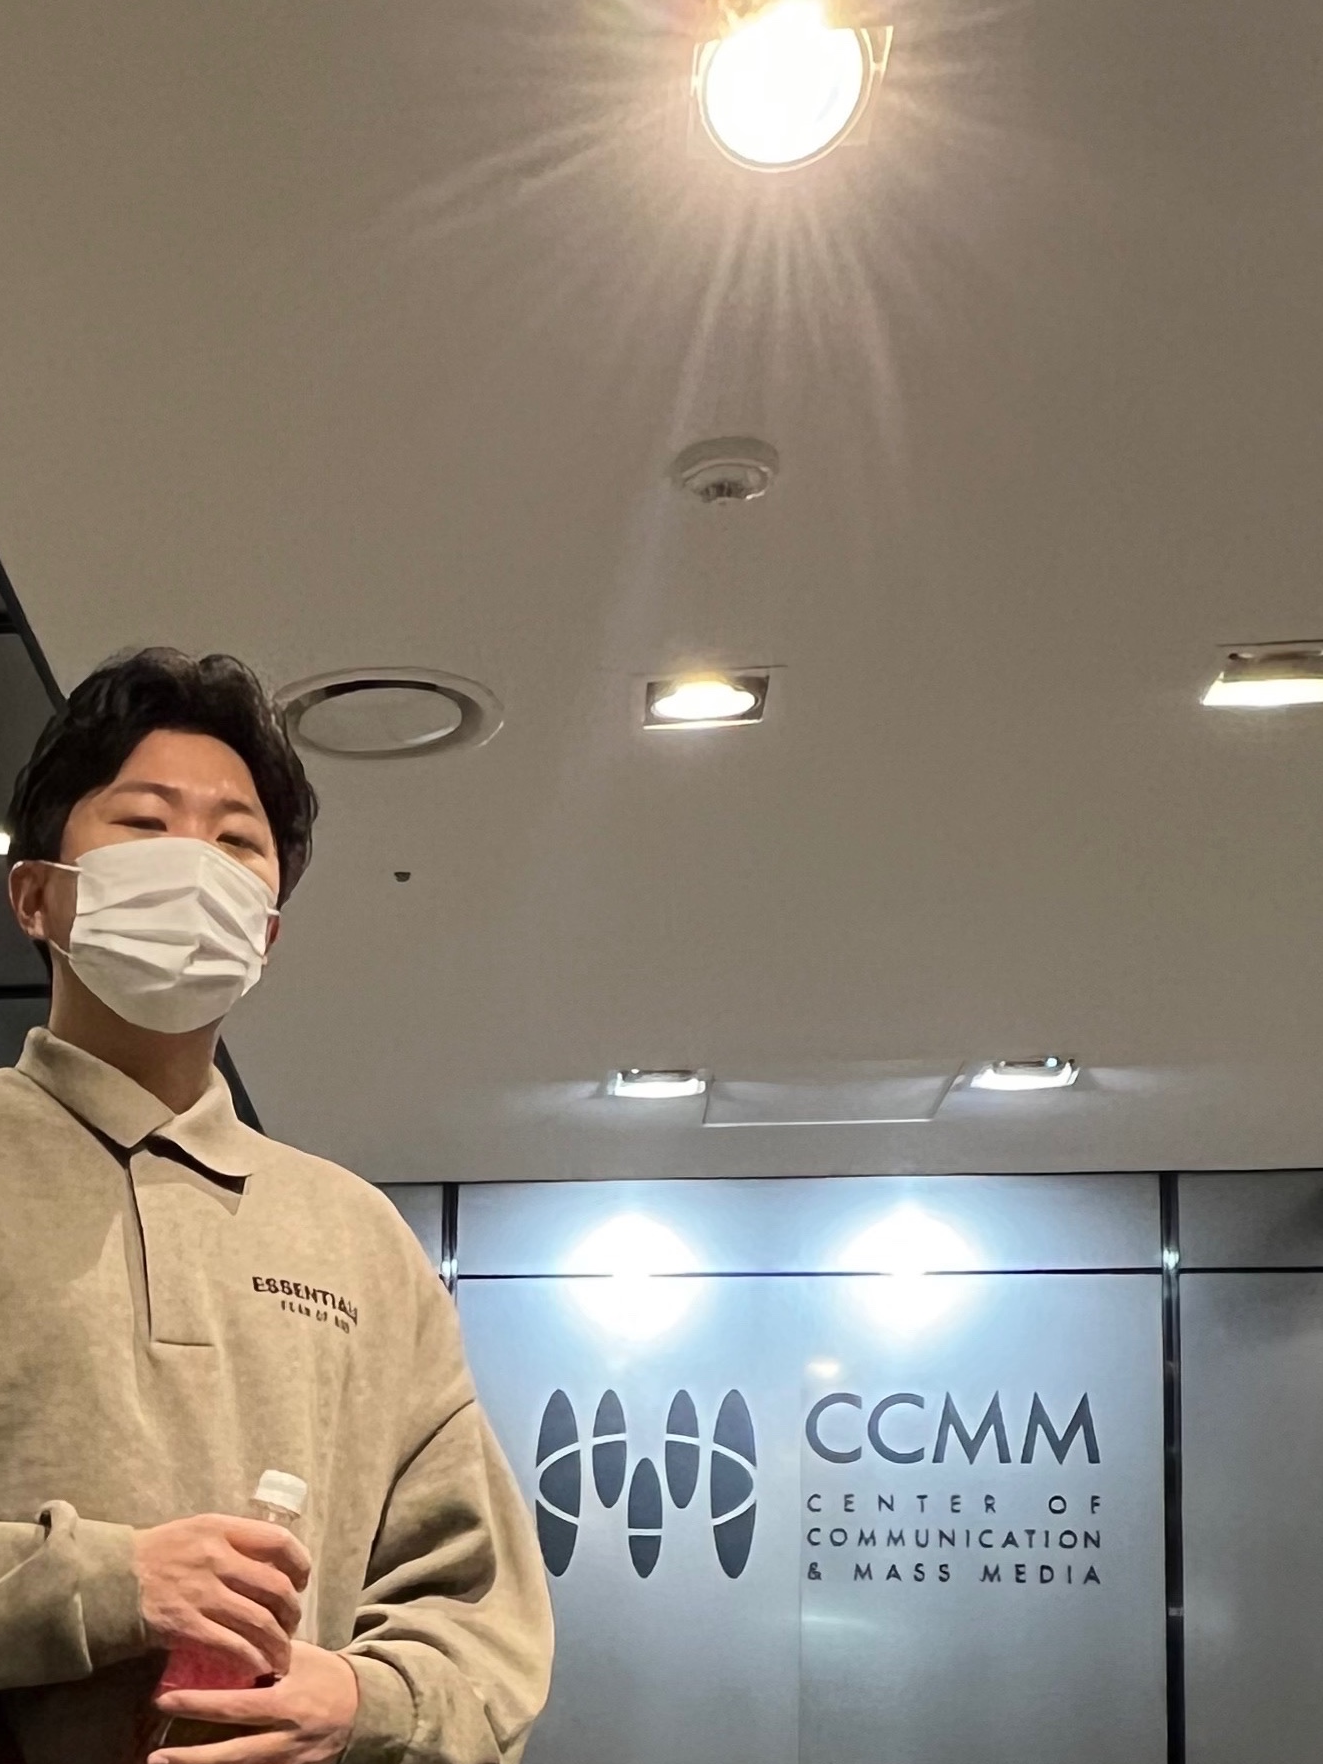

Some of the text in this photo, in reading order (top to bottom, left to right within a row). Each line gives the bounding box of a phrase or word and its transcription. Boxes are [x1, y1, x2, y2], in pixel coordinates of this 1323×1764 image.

[805, 1391, 1101, 1465] CCMM
[807, 1493, 1101, 1514] CENTER OF
[806, 1527, 1101, 1549] COMMUNICATION
[807, 1562, 1101, 1584] & MASS MEDIA
